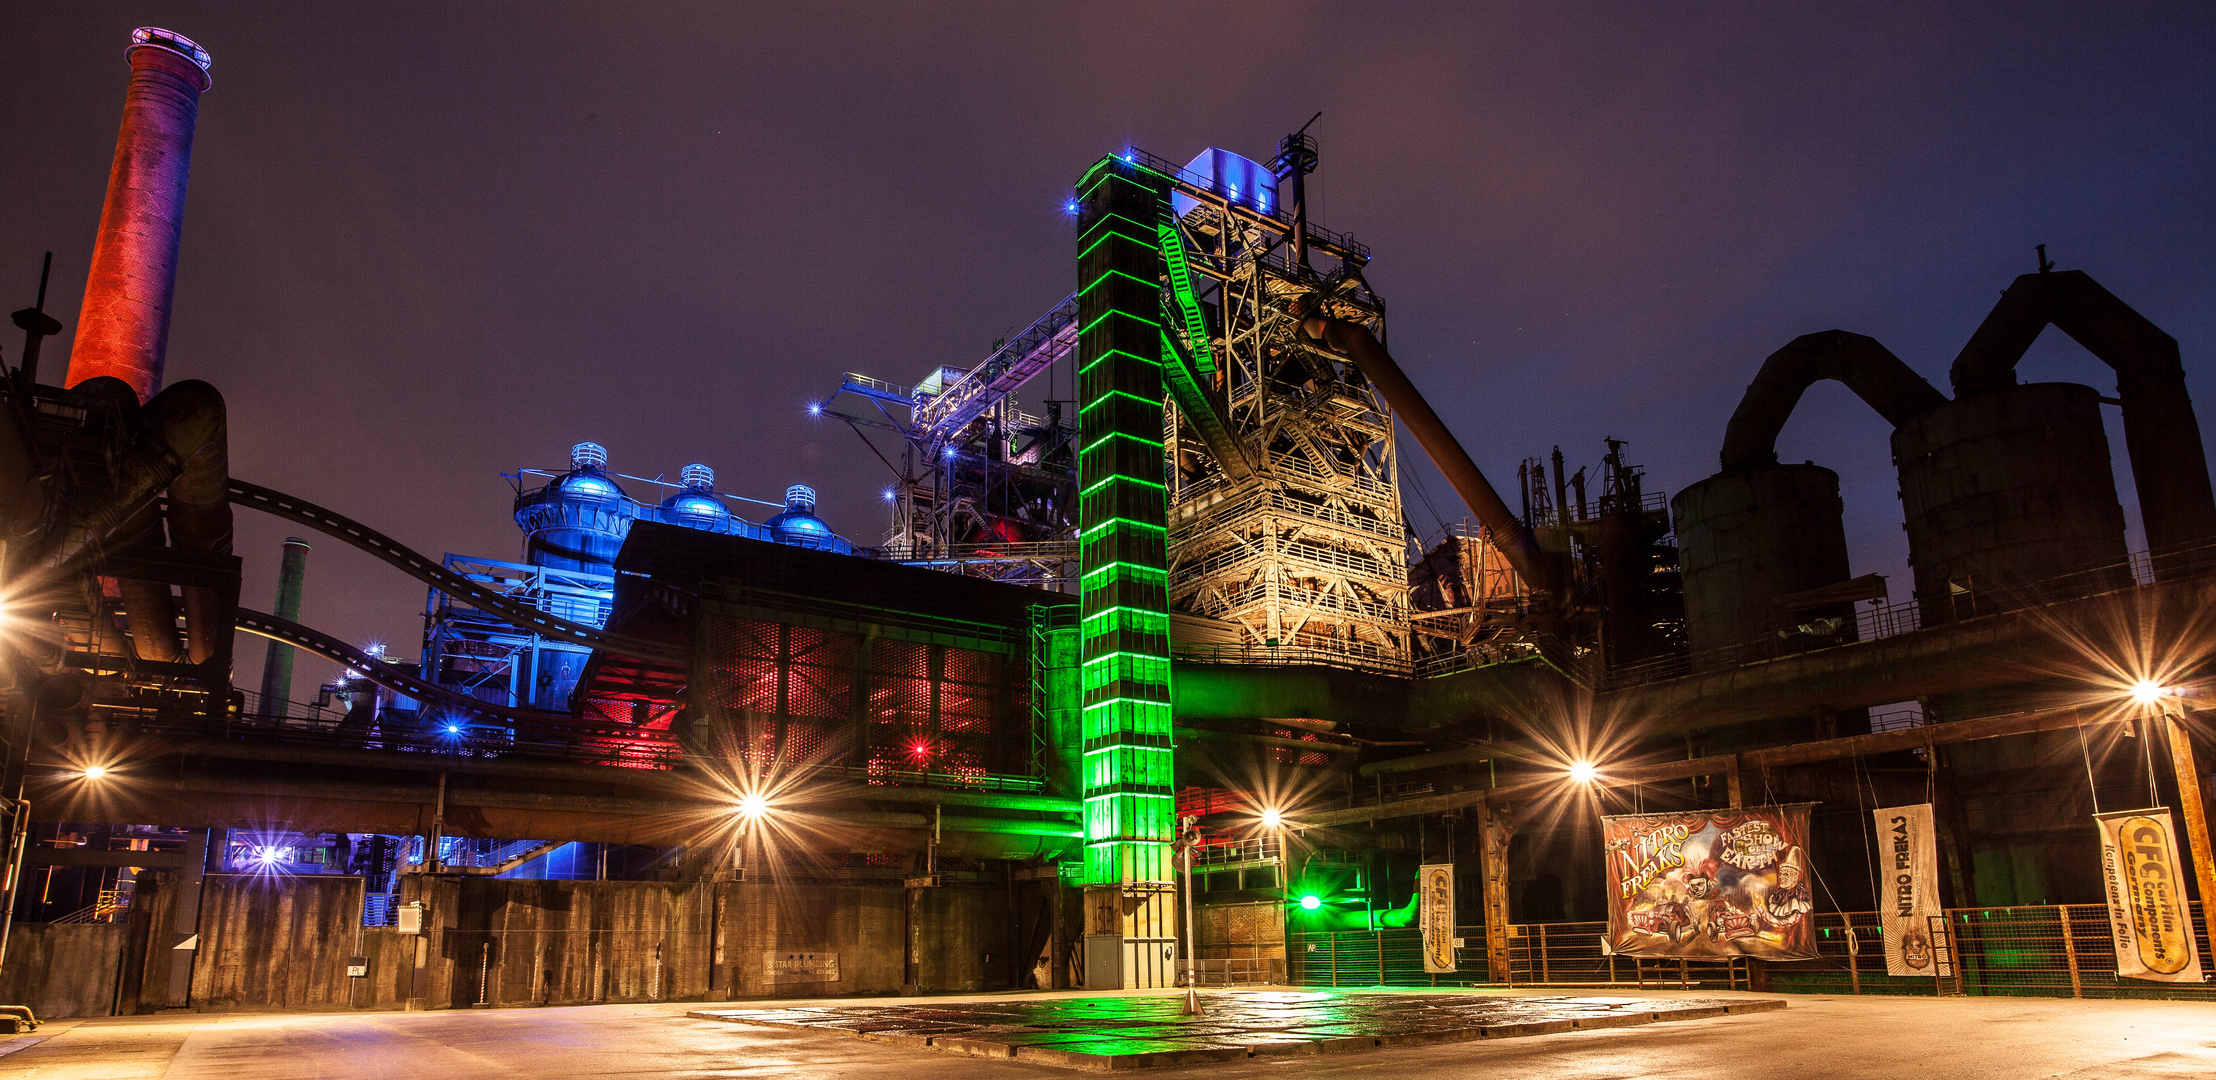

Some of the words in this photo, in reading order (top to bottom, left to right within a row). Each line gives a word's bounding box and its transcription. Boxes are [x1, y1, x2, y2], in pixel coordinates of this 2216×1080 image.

[1620, 824, 1689, 881] NITRO
[1720, 822, 1770, 847] FASTEST
[1744, 833, 1789, 851] SHOW
[1891, 815, 1910, 870] FREKAS
[2133, 826, 2167, 879] CFC
[1621, 841, 1686, 899] FREAKS
[1719, 848, 1778, 870] EARTH
[2105, 844, 2120, 908] Kompetenz
[1435, 875, 1448, 910] CFC
[1897, 873, 1913, 917] NITRO
[2114, 908, 2122, 919] in
[2127, 850, 2147, 939] Germany
[2157, 880, 2175, 933] CarFilm
[2117, 922, 2131, 949] Folie
[2143, 881, 2165, 960] Components
[767, 960, 772, 969] 3
[774, 960, 792, 968] STAR
[794, 959, 835, 968] PLUMBING
